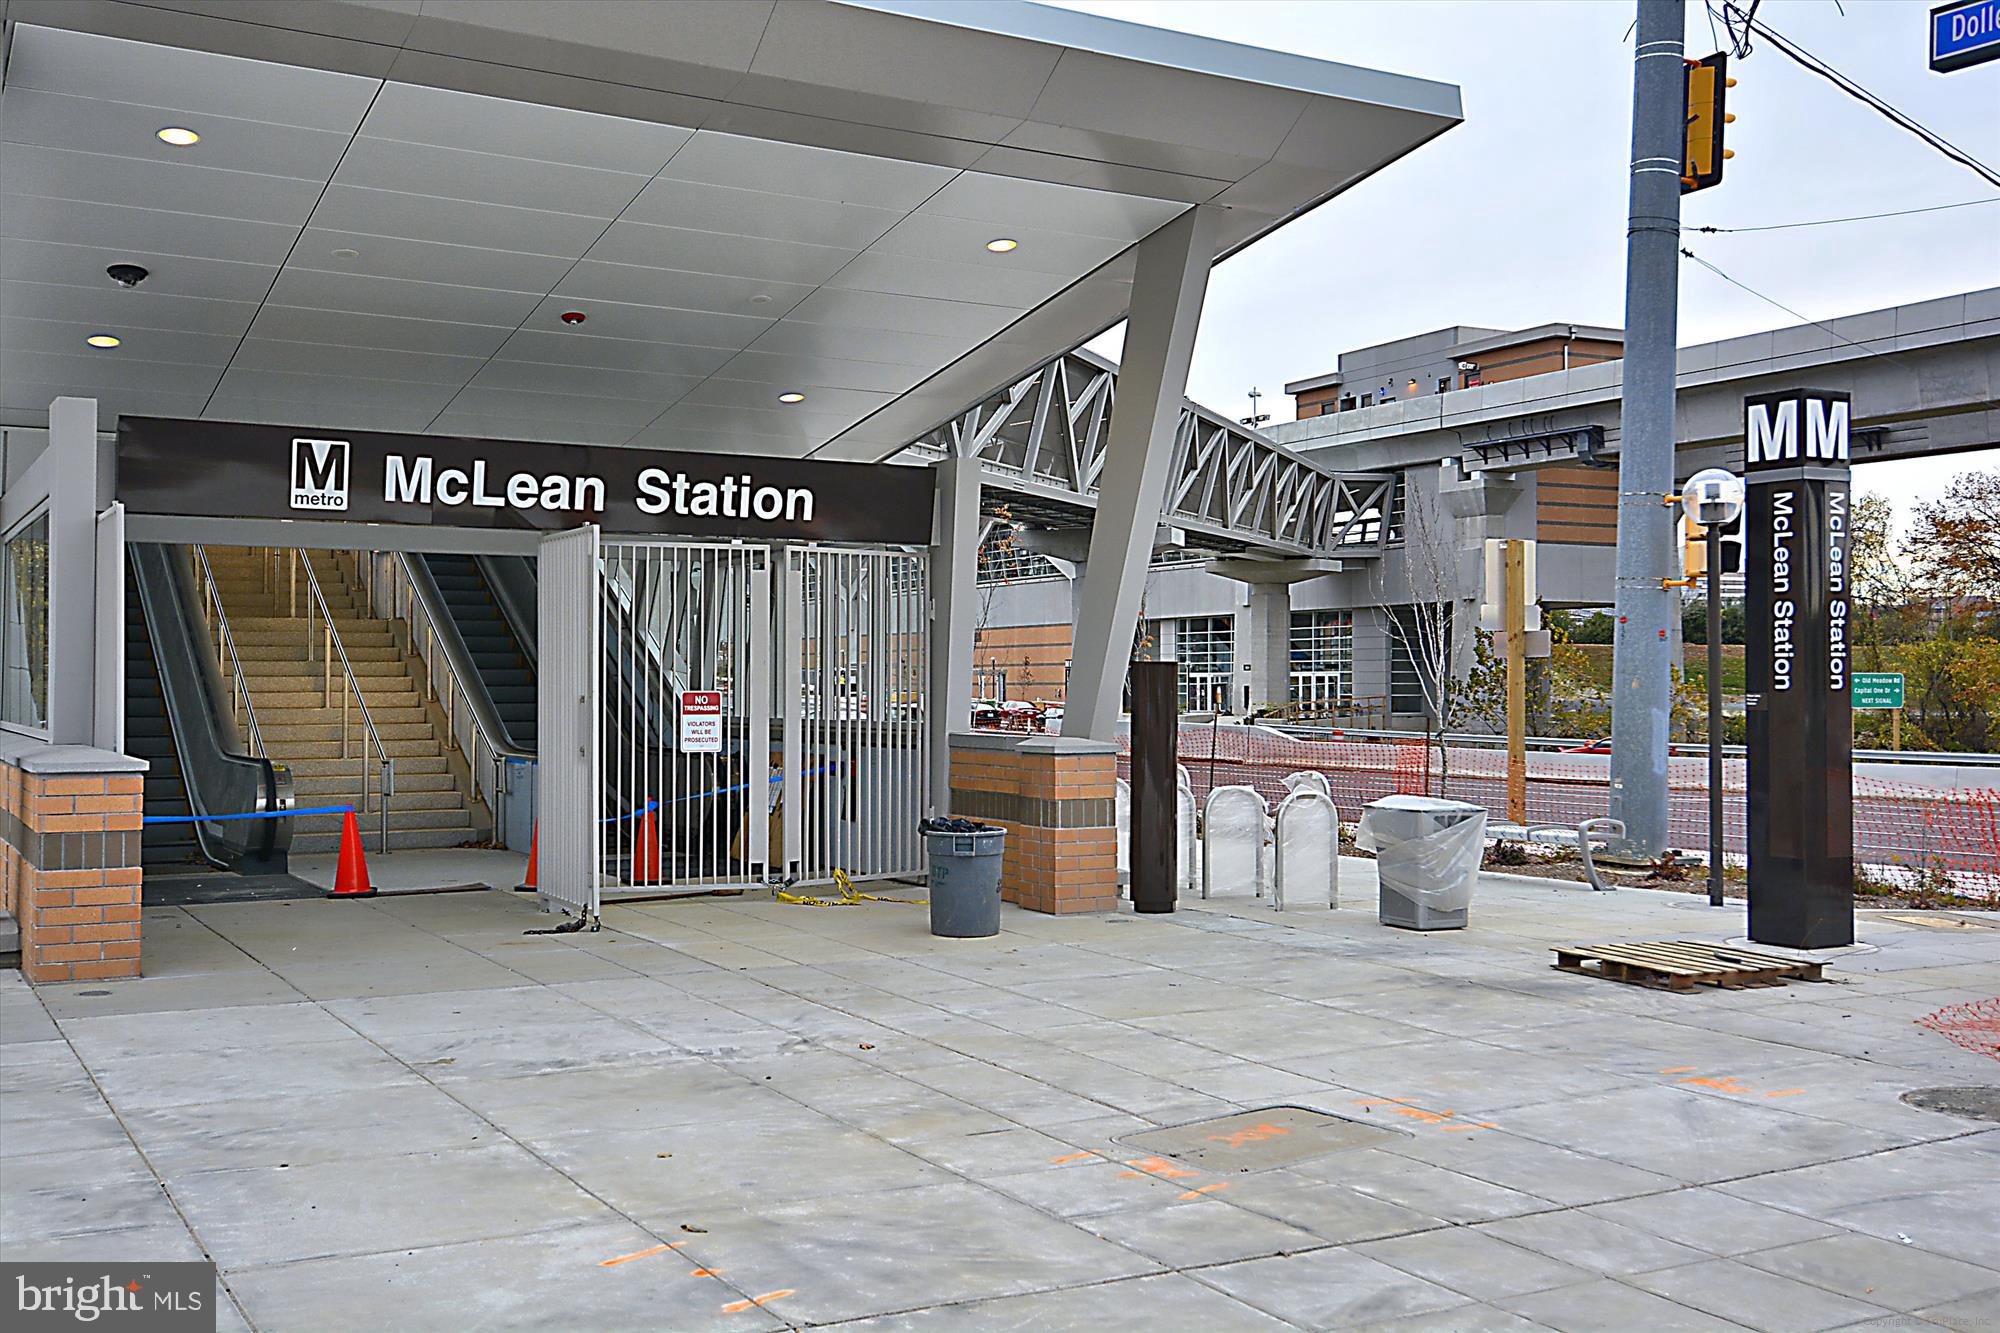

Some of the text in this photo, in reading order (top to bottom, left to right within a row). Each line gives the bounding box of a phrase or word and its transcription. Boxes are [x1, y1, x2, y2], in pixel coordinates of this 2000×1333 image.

[1747, 399, 1798, 463] M
[1806, 398, 1849, 460] M
[294, 491, 344, 507] metro
[384, 455, 813, 521] McLean Station
[1773, 491, 1795, 690] McLean Station
[1828, 491, 1847, 690] McLean Station
[694, 695, 708, 704] NO
